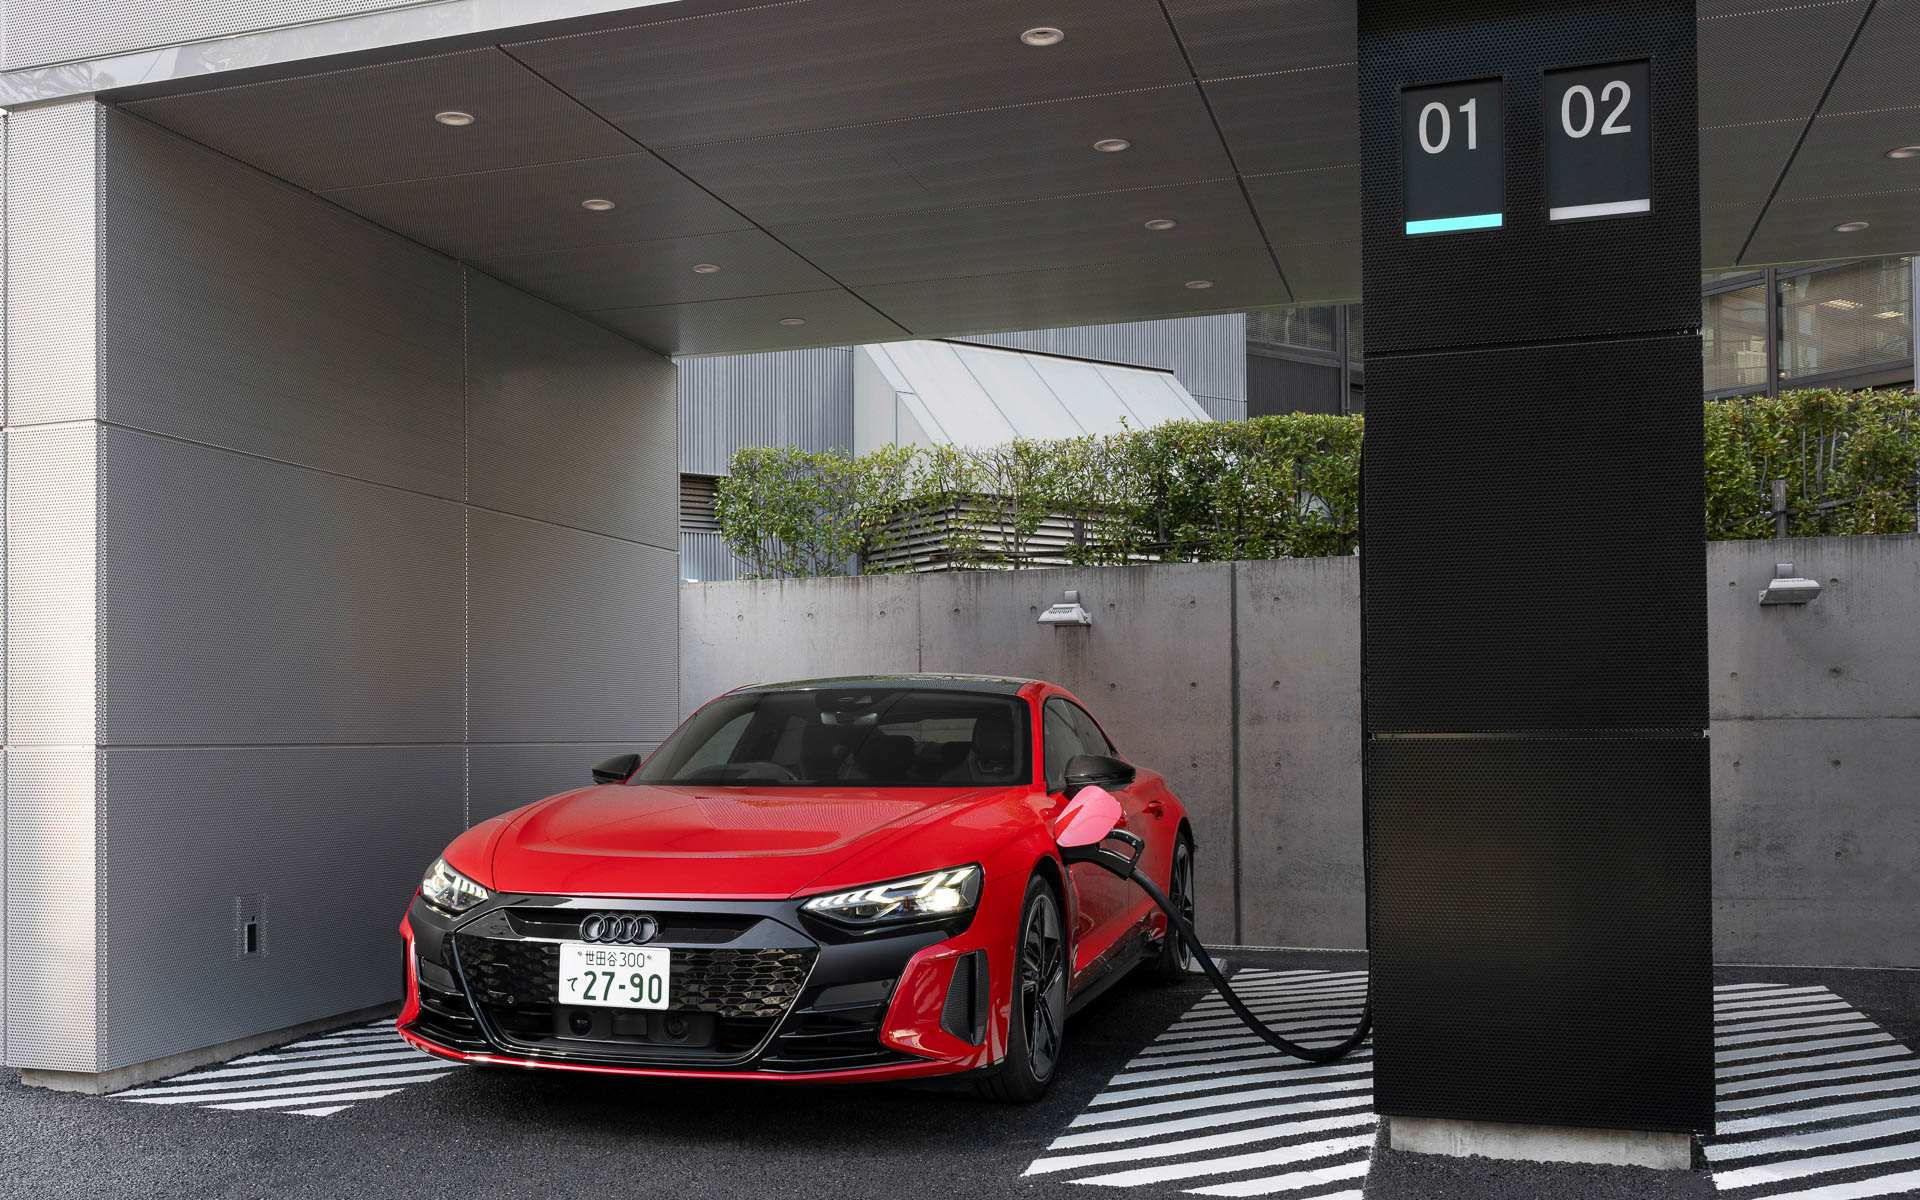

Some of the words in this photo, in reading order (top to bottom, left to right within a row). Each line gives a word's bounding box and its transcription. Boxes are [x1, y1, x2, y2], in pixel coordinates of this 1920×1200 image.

[1418, 98, 1477, 154] 01
[1561, 80, 1632, 139] 02
[566, 977, 579, 992] て
[582, 970, 663, 1004] 27-90
